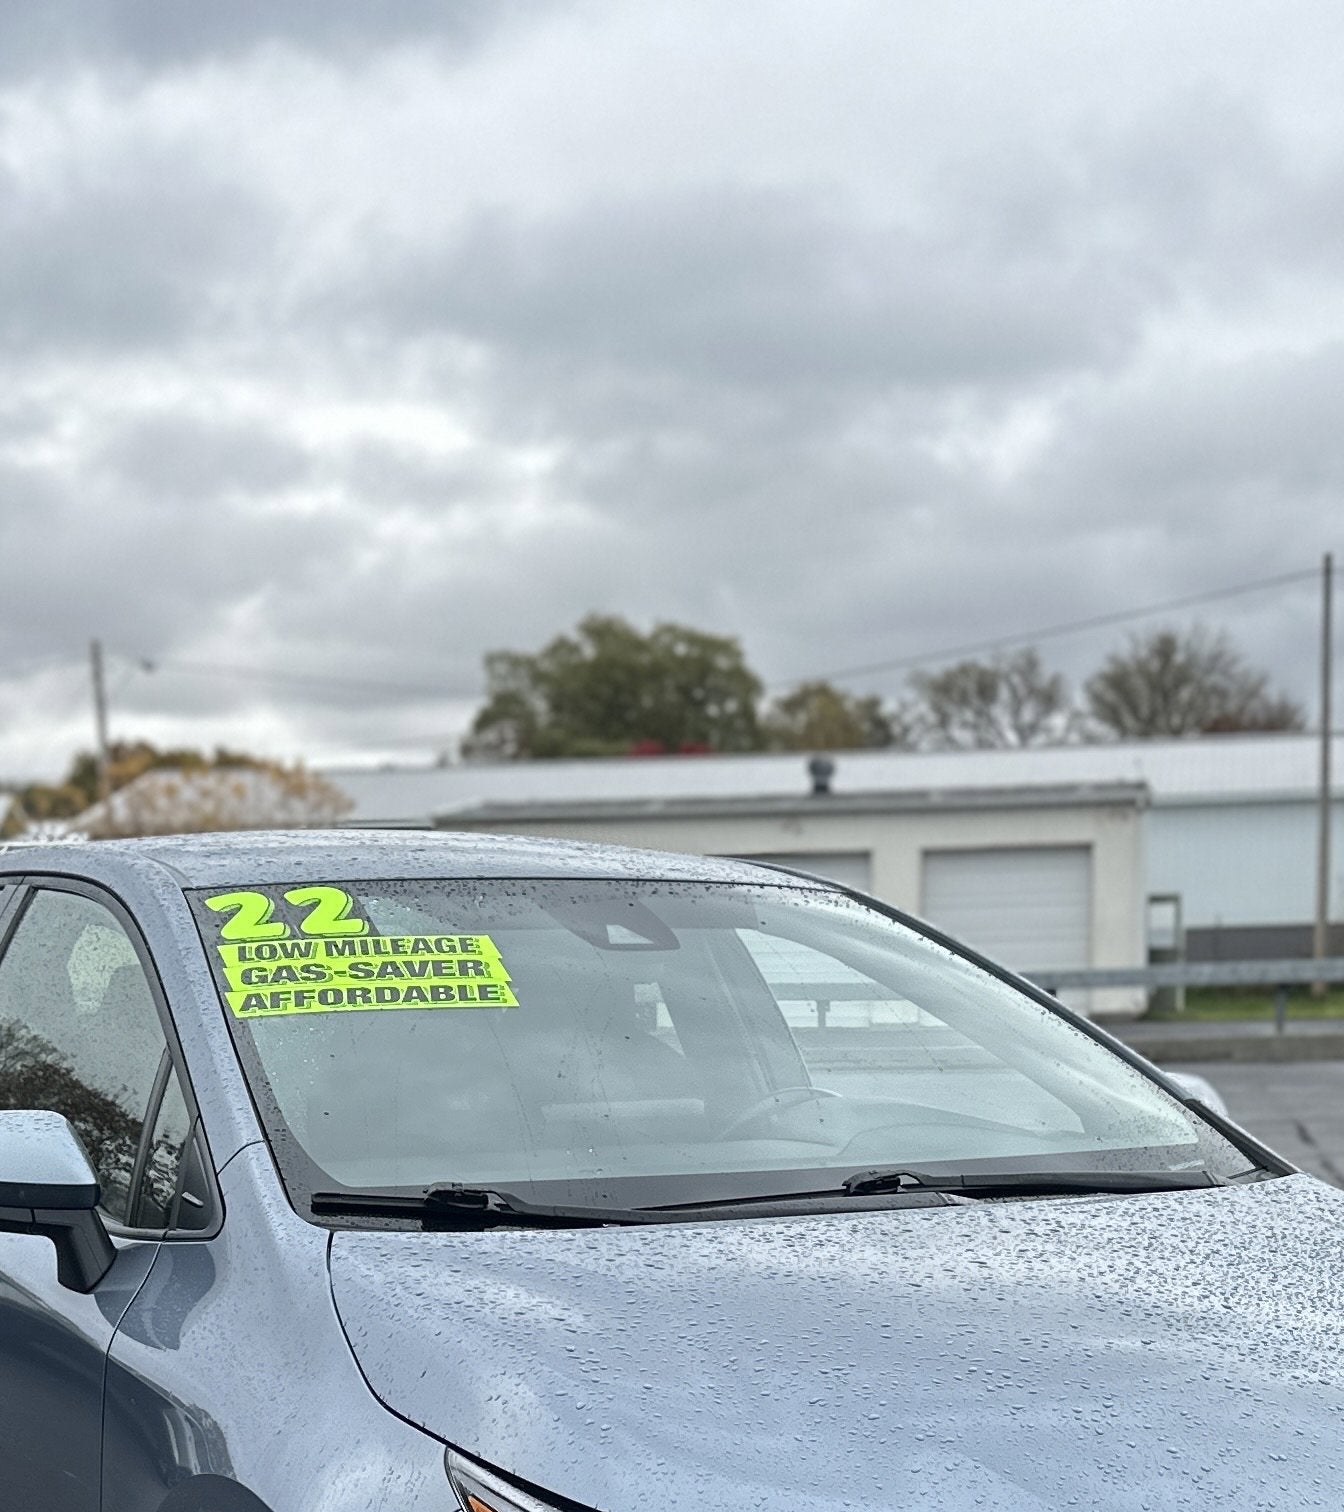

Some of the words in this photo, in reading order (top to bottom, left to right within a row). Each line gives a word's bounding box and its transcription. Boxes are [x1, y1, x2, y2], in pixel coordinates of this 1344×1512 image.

[205, 886, 369, 941] 22
[237, 941, 318, 963] LOW
[324, 937, 482, 958] MILEAGE
[240, 959, 493, 987] GAS-SAVER
[239, 984, 507, 1013] AFFORDABLE
